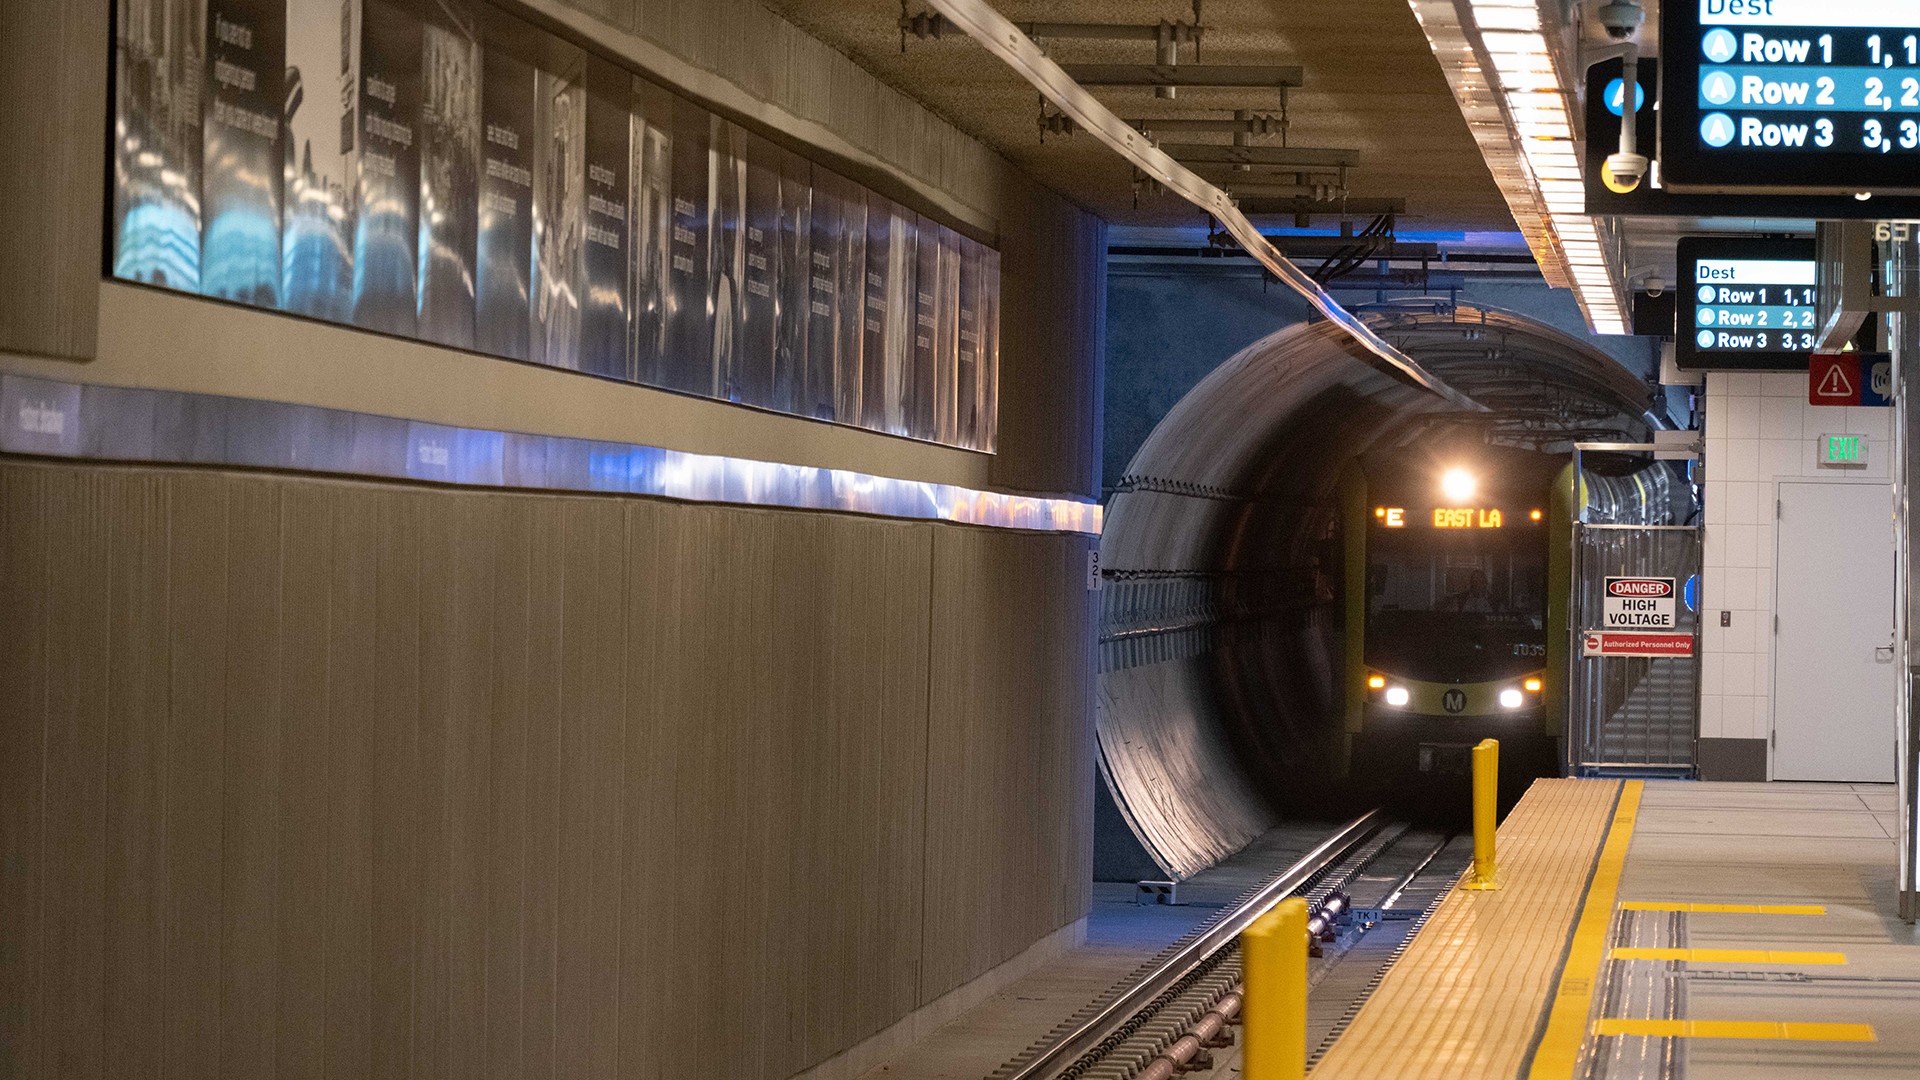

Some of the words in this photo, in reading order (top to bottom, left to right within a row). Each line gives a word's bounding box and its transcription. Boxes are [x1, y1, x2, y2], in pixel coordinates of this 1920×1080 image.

[1707, 0, 1773, 15] Dest
[1711, 34, 1729, 56] A
[1743, 33, 1811, 63] Row
[1818, 34, 1833, 63] 1
[1867, 34, 1893, 69] 1,
[1710, 76, 1728, 98] A
[1741, 75, 1809, 105] Row
[1815, 76, 1835, 105] 2
[1864, 77, 1892, 111] 2,
[1901, 77, 1920, 106] 2
[1709, 118, 1728, 140] A
[1741, 117, 1809, 146] Row
[1814, 118, 1834, 147] 3
[1863, 119, 1891, 153] 3,
[1900, 119, 1920, 148] 3
[1700, 265, 1735, 280] Dest
[1702, 288, 1711, 300] A
[1718, 287, 1755, 303] Row
[1758, 288, 1766, 303] 1
[1784, 288, 1799, 306] 1,
[1702, 311, 1711, 322] A
[1718, 310, 1754, 325] Row
[1757, 310, 1768, 326] 2
[1782, 311, 1798, 328] 2,
[1801, 311, 1815, 326] 2
[1701, 333, 1711, 345] A
[1718, 332, 1754, 348] Row
[1757, 333, 1767, 348] 3
[1782, 333, 1798, 351] 3,
[1801, 333, 1814, 349] 3
[1829, 437, 1859, 460] EXIT
[1387, 508, 1404, 526] E
[1434, 508, 1474, 527] EAST
[1479, 508, 1501, 528] LA
[1615, 583, 1665, 594] DANGER
[1622, 599, 1657, 611] HIGH
[1609, 613, 1670, 625] VOLTAGE
[1641, 641, 1674, 649] Personnel
[1675, 642, 1690, 650] Only
[1446, 694, 1463, 709] M
[1356, 911, 1370, 920] TK
